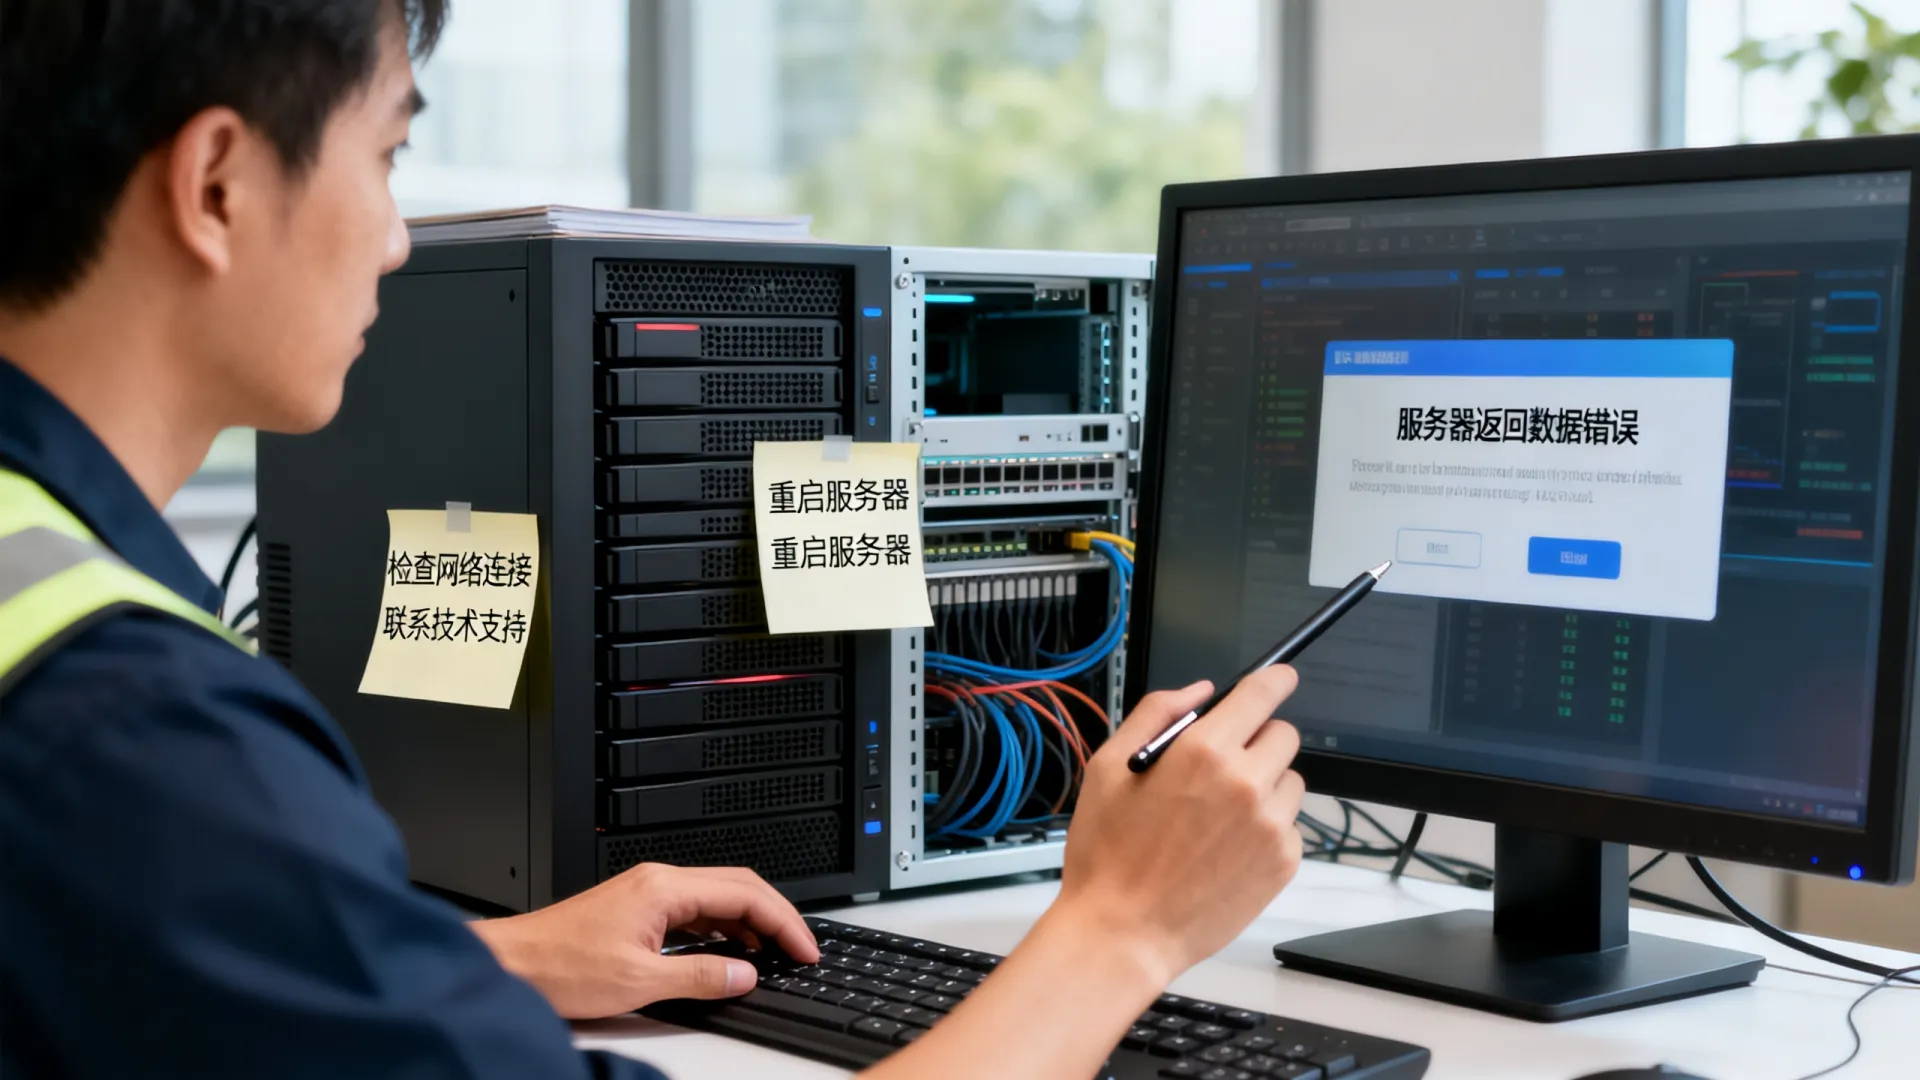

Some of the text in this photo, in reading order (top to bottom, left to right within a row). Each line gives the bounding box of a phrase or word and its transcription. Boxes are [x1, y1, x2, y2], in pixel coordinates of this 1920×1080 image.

[1396, 405, 1640, 446] 服务器返回数据错误
[768, 478, 910, 514] 重启服务器
[387, 550, 532, 588] 检查网络连接
[770, 532, 912, 570] 重启服务器
[383, 605, 527, 644] 联系技术支持
